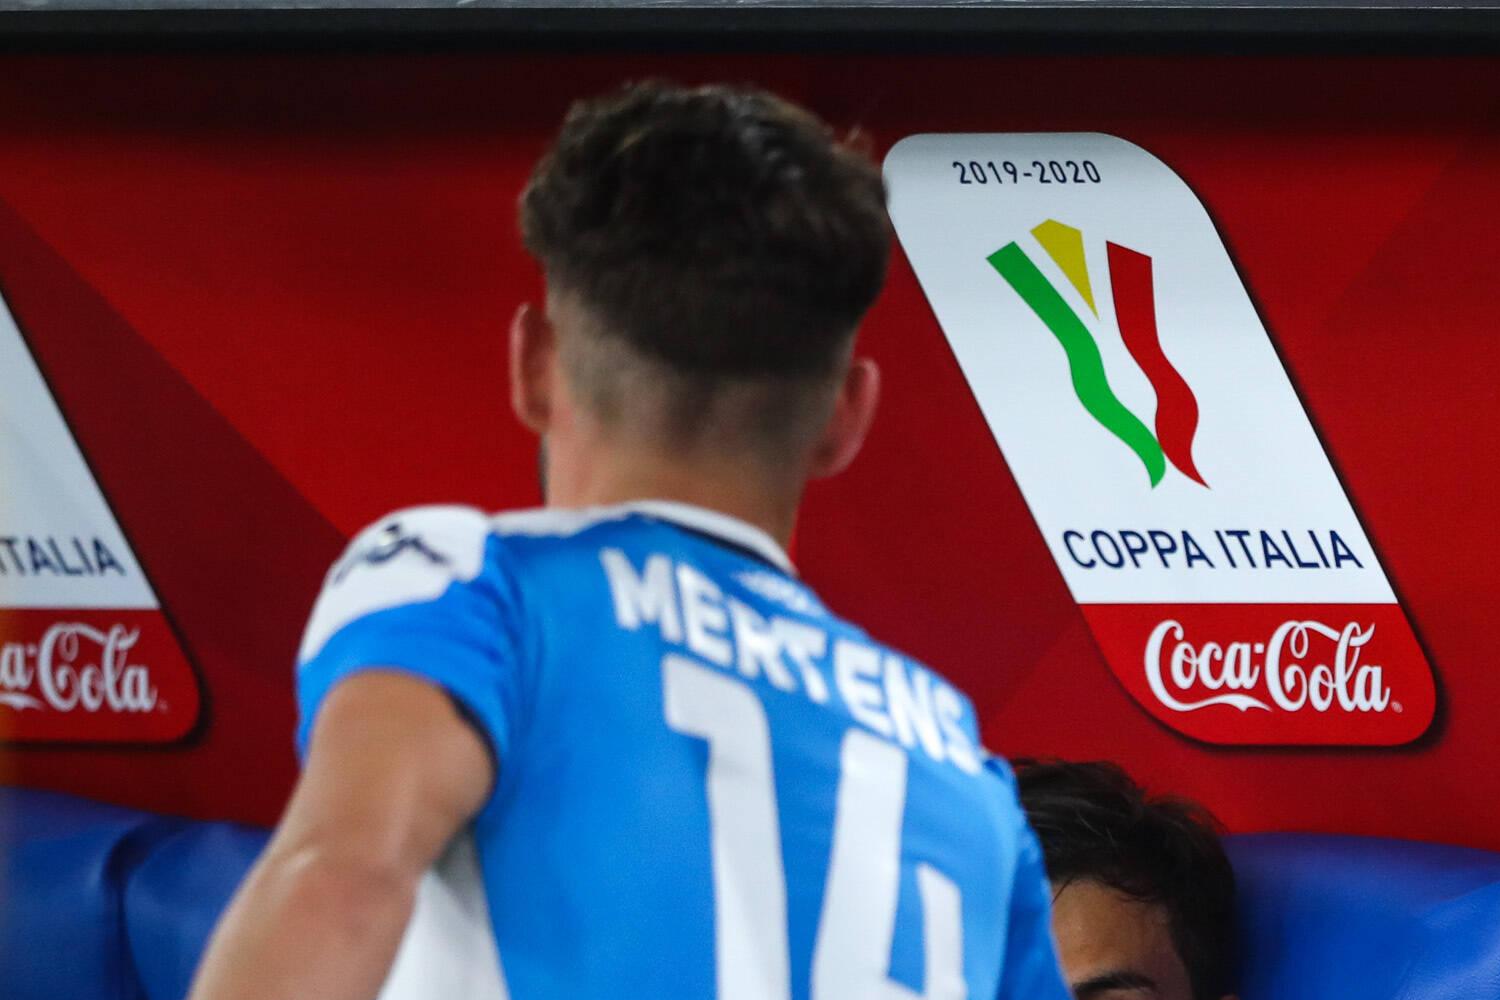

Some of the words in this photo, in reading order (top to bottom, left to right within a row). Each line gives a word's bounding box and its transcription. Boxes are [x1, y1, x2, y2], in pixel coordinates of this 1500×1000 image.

[952, 159, 1101, 185] 2019-2020
[1062, 530, 1215, 569] COPPA
[1213, 530, 1364, 569] ITALIA
[600, 547, 982, 775] MERTENS
[1144, 619, 1391, 712] Coca-Cola
